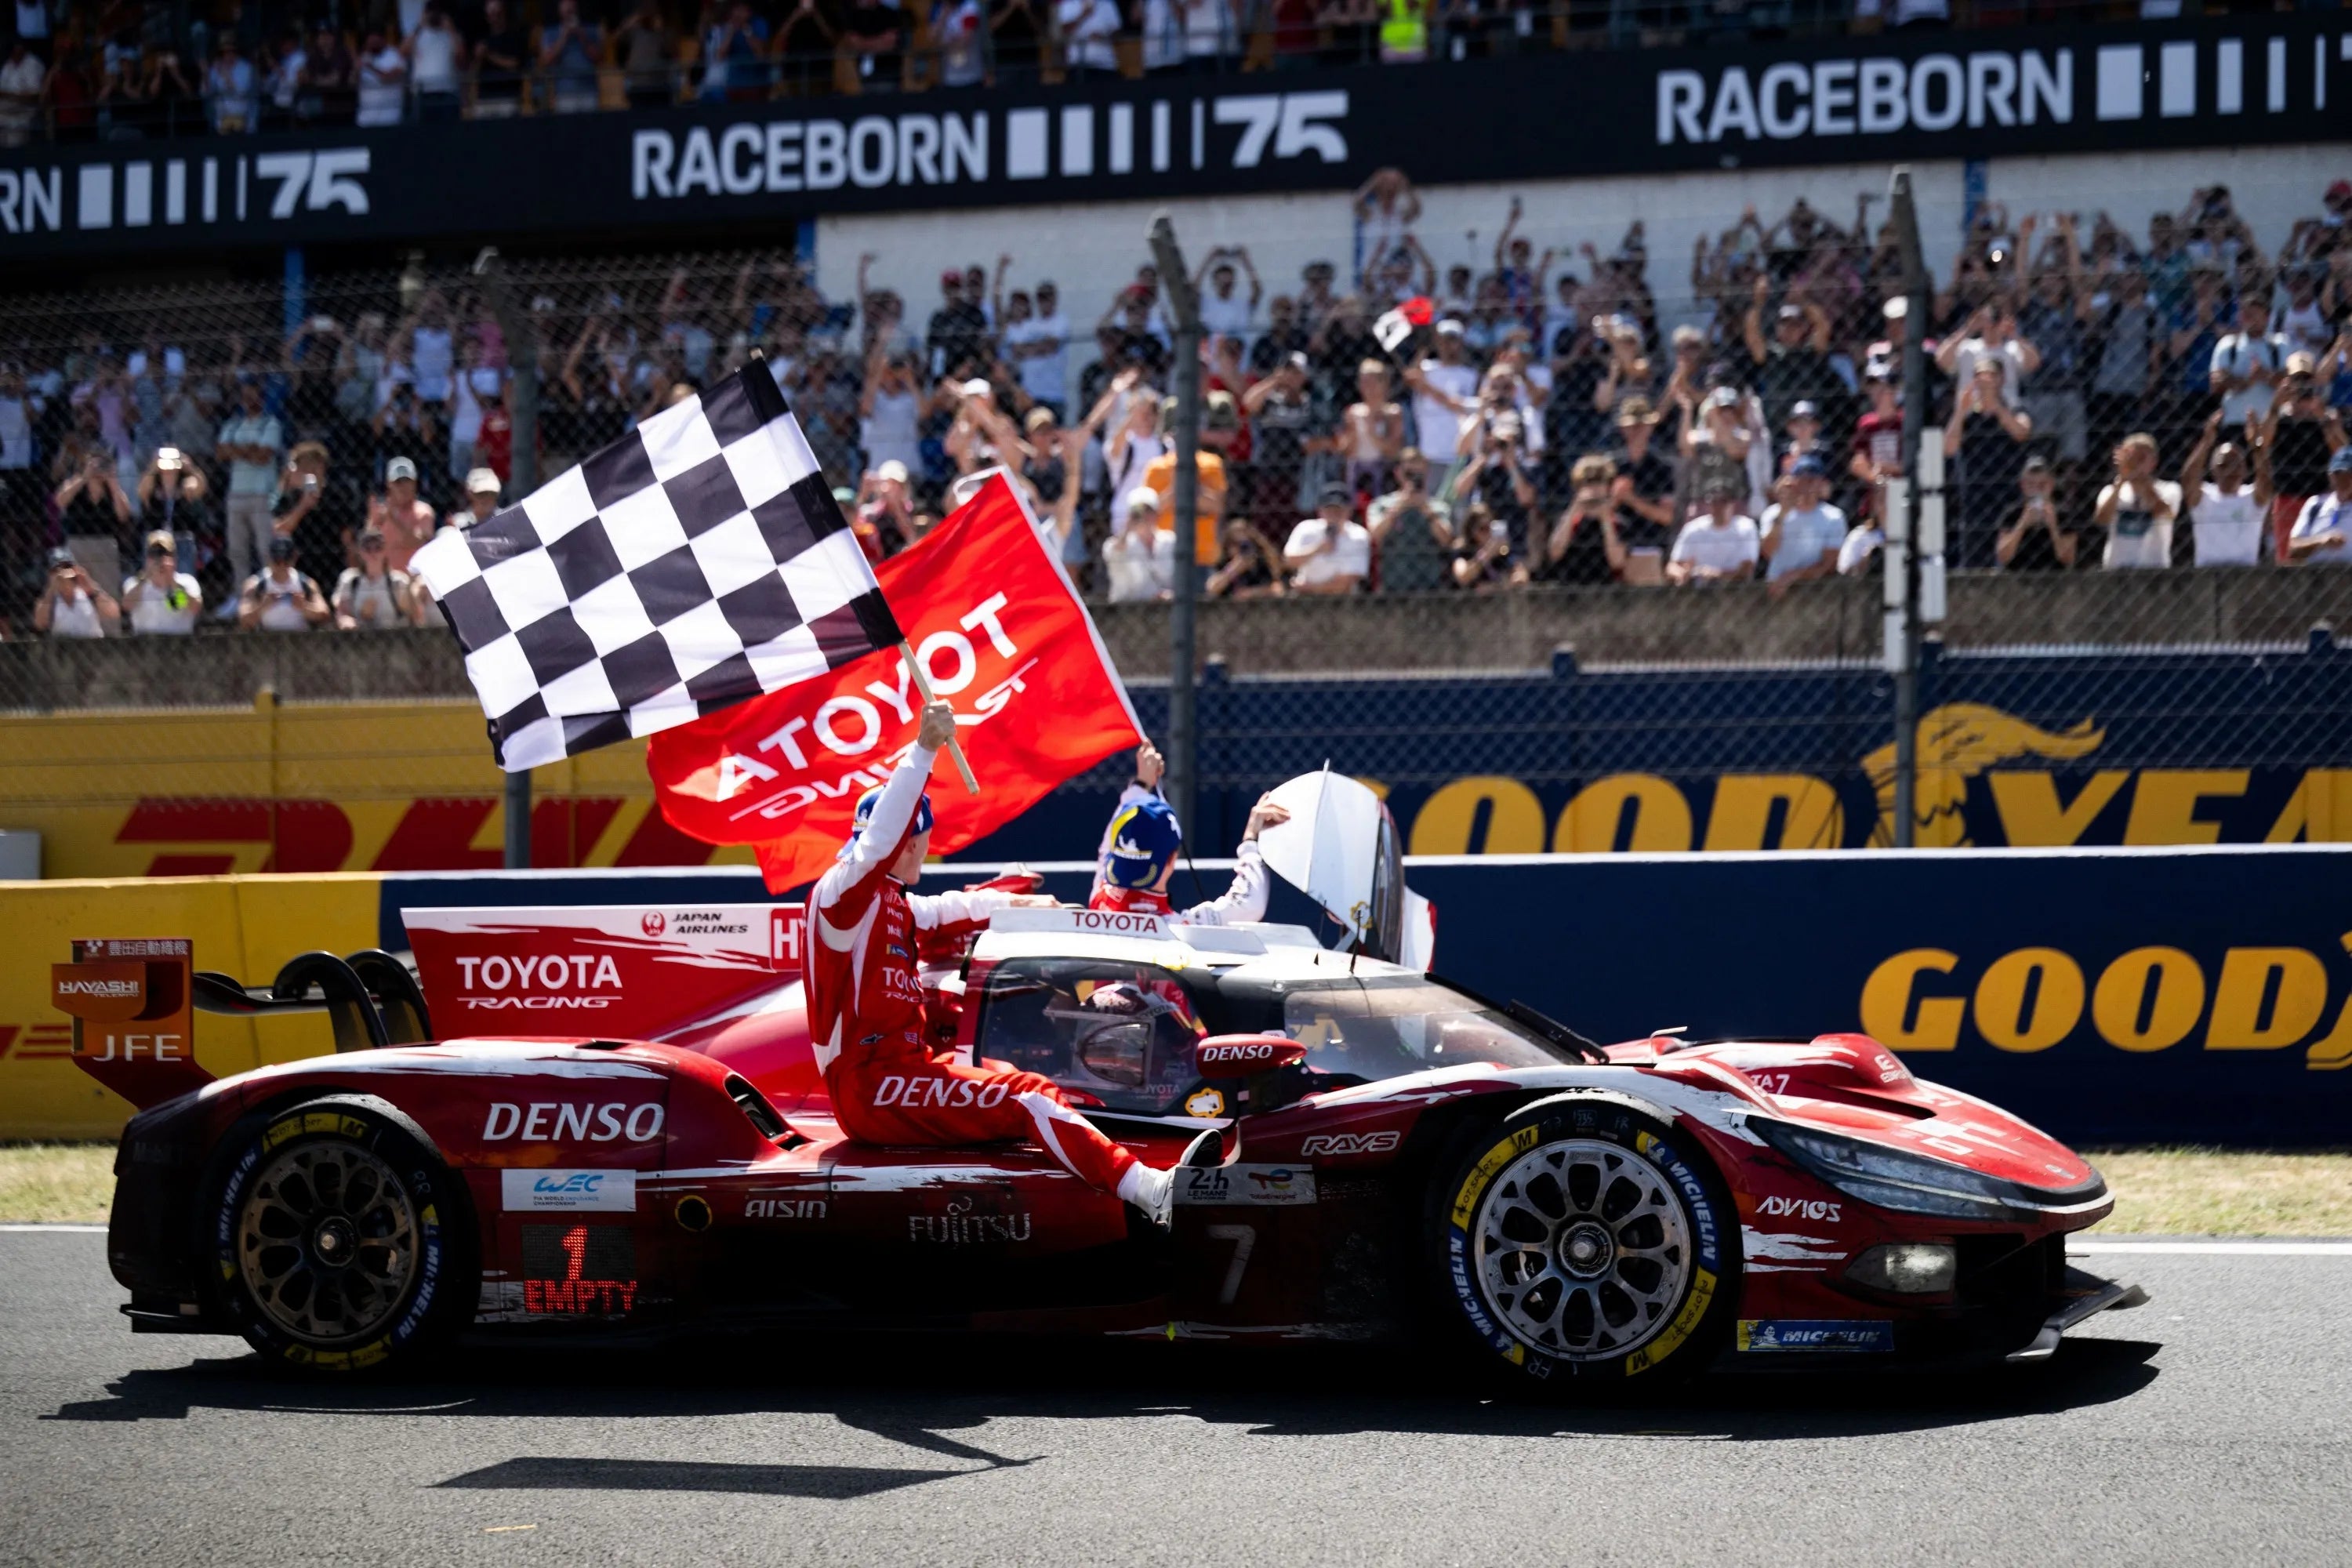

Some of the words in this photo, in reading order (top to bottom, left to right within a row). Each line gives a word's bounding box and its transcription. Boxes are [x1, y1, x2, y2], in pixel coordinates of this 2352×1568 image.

[1656, 47, 2074, 146] RACEBORN
[631, 111, 989, 200] RACEBORN
[1214, 89, 1349, 169] 75
[256, 146, 370, 220] 75
[672, 913, 722, 922] JAPAN
[676, 924, 749, 935] AIRLINES
[1072, 911, 1159, 934] TOYOTA
[58, 980, 140, 994] HAYASHI
[456, 954, 623, 990] TOYOTA
[456, 995, 623, 1010] RACING
[1859, 946, 2329, 1054] GOOD
[92, 1034, 183, 1062] JFE
[1202, 1044, 1274, 1063] DENSO
[873, 1075, 1010, 1109] DENSO
[482, 1102, 665, 1142] DENSO
[1301, 1130, 1401, 1156] RAYS
[534, 1174, 604, 1192] WEC
[745, 1199, 827, 1219] AISIN
[1671, 1160, 1715, 1261] MICHELIN
[907, 1211, 1032, 1247] FUJITSU
[561, 1225, 588, 1279] 1
[1206, 1224, 1257, 1305] 7
[523, 1279, 637, 1314] EMPTY
[1450, 1237, 1497, 1339] MICHELIN
